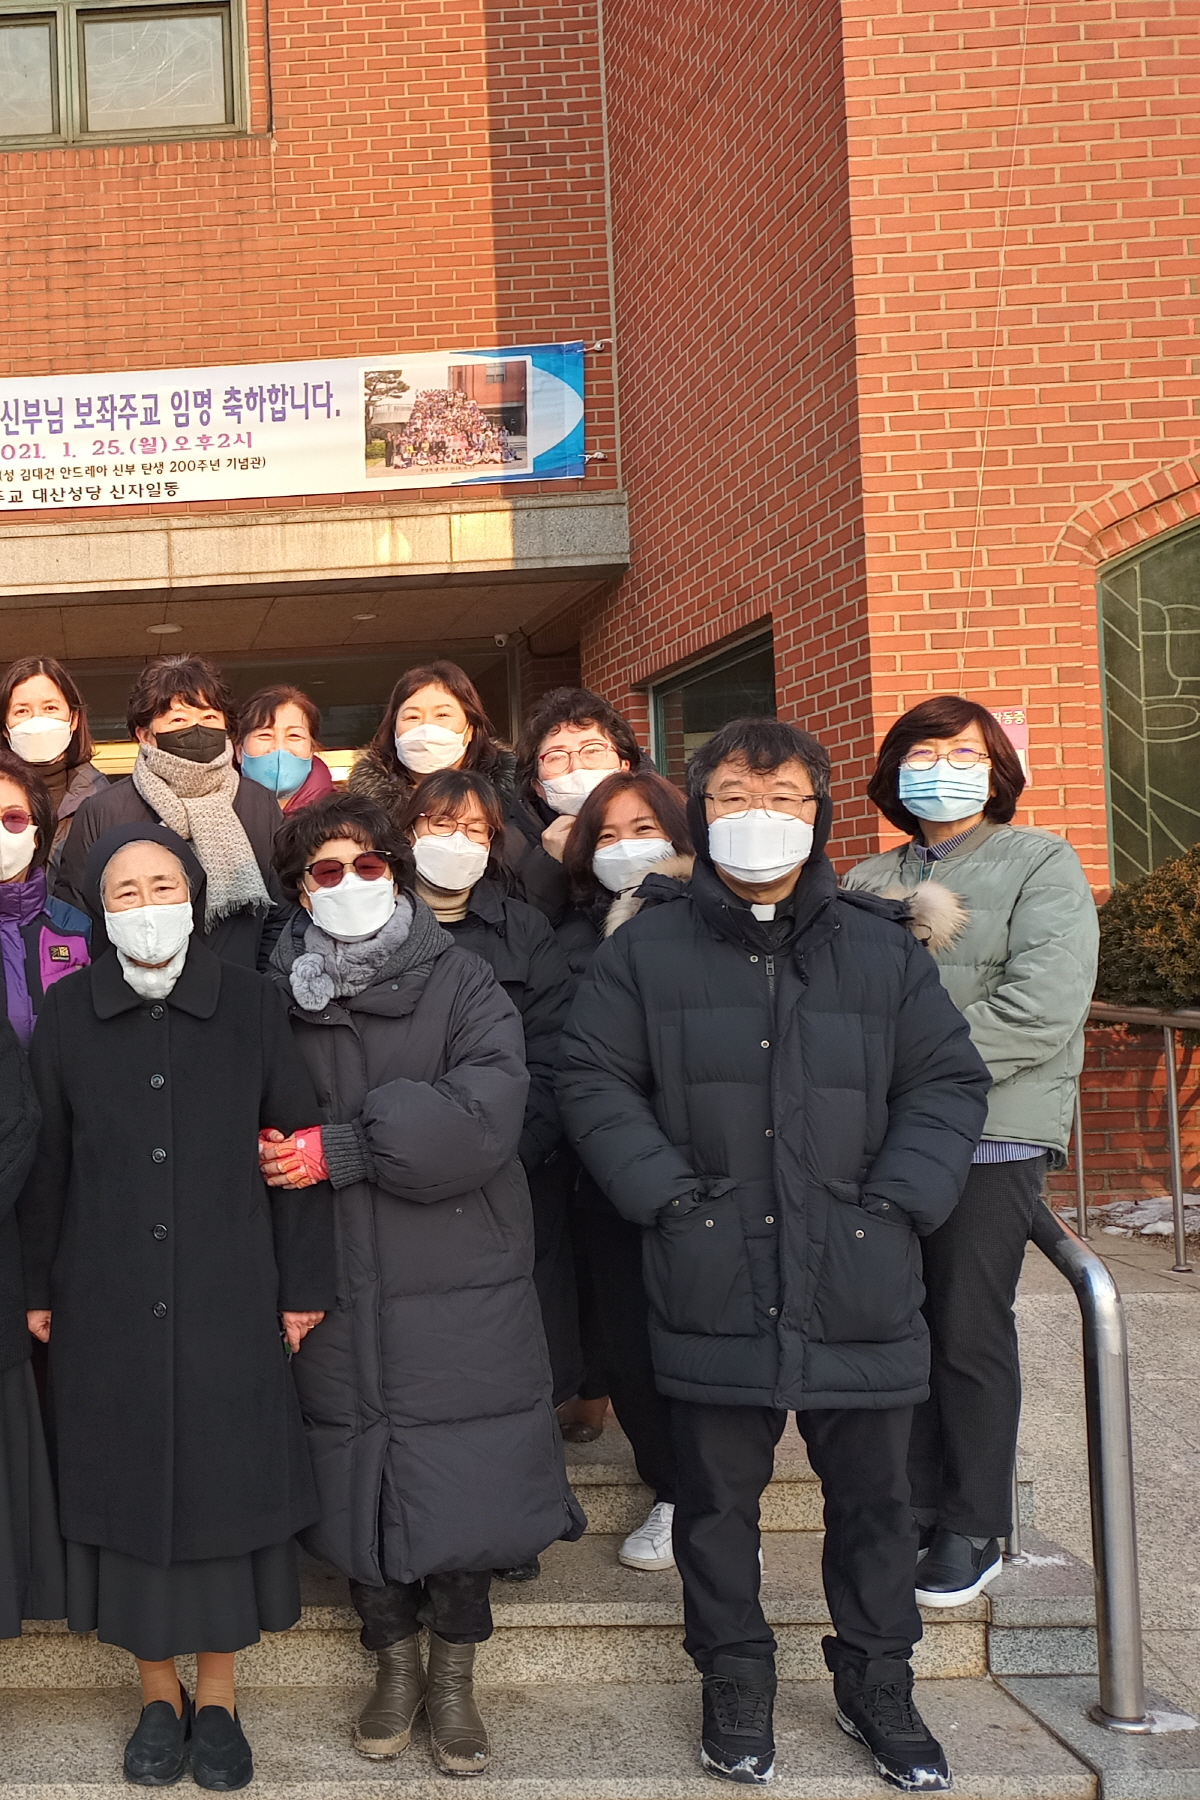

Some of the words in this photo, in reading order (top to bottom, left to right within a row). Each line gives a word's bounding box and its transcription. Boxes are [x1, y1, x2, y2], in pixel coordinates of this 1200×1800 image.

[0, 397, 64, 436] 신부님
[74, 393, 161, 431] 보좌주교
[171, 388, 213, 428] 임명
[222, 381, 341, 424] 축하합니다.
[63, 442, 77, 458] 1.
[20, 467, 55, 482] 김대건
[60, 465, 107, 479] 안드레아
[112, 464, 136, 477] 신부
[141, 461, 164, 475] 탄생
[169, 458, 220, 473] 200주년
[226, 456, 266, 470] 기념관)
[32, 485, 102, 503] 대산성당
[109, 481, 180, 500] 신자일동
